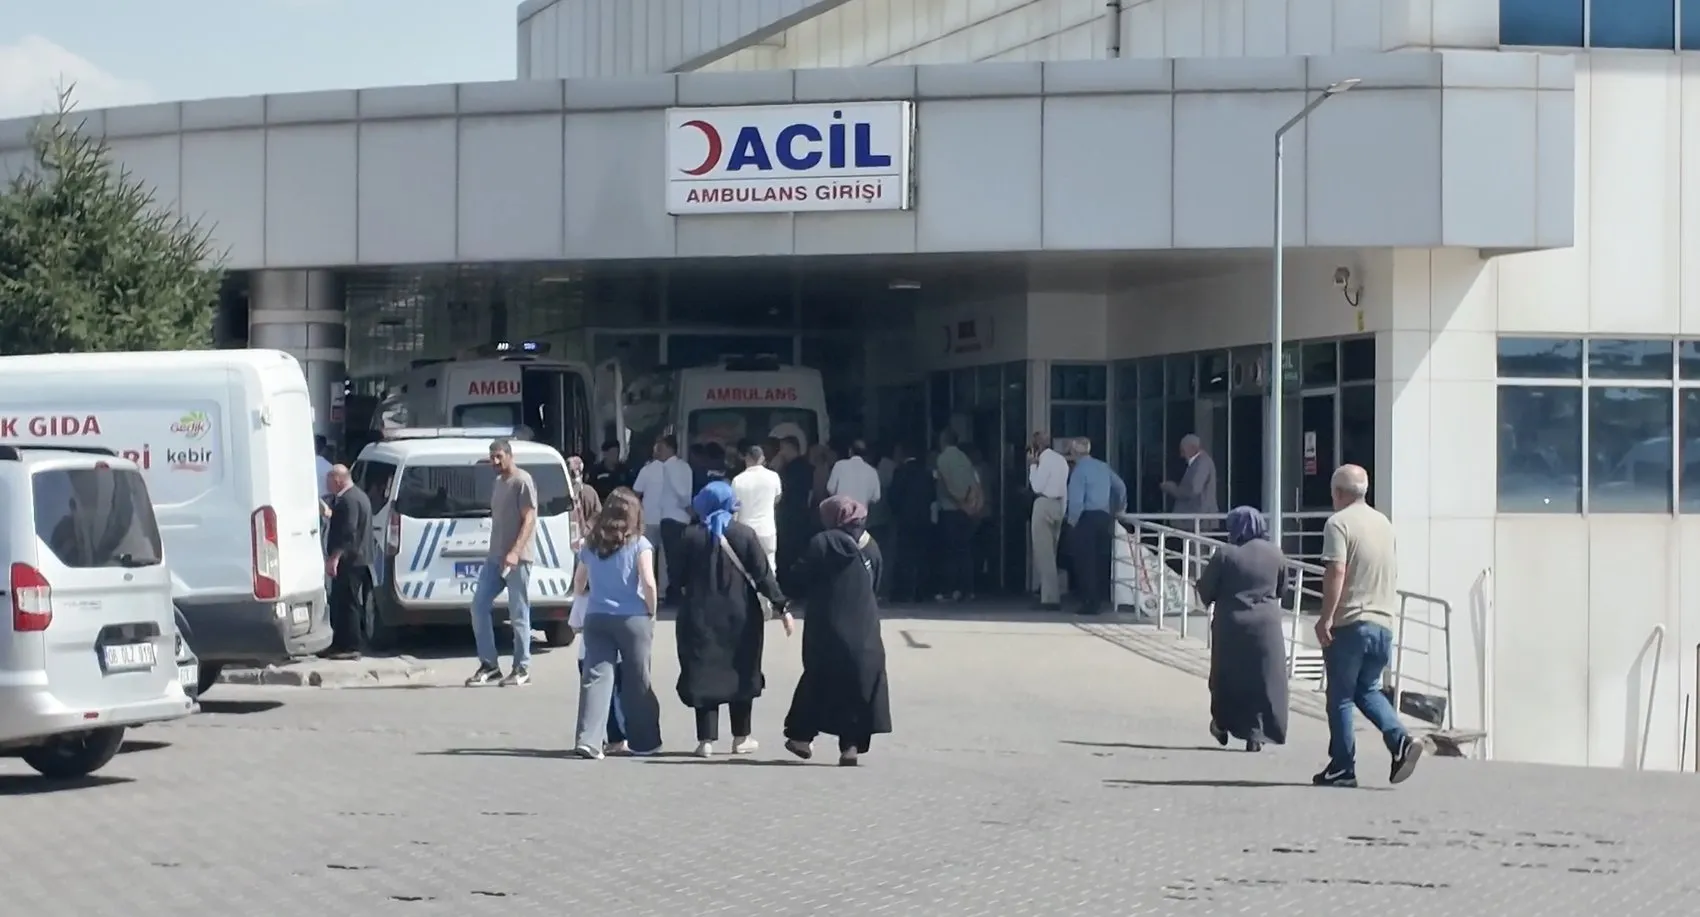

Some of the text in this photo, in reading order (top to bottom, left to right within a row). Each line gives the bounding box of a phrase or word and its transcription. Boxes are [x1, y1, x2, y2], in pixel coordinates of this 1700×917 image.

[726, 110, 891, 171] ACİL
[686, 179, 882, 203] AMBULANS GİRİŞİ
[706, 386, 797, 401] AMBULANS
[28, 414, 101, 437] GIDA
[167, 446, 213, 465] kebir
